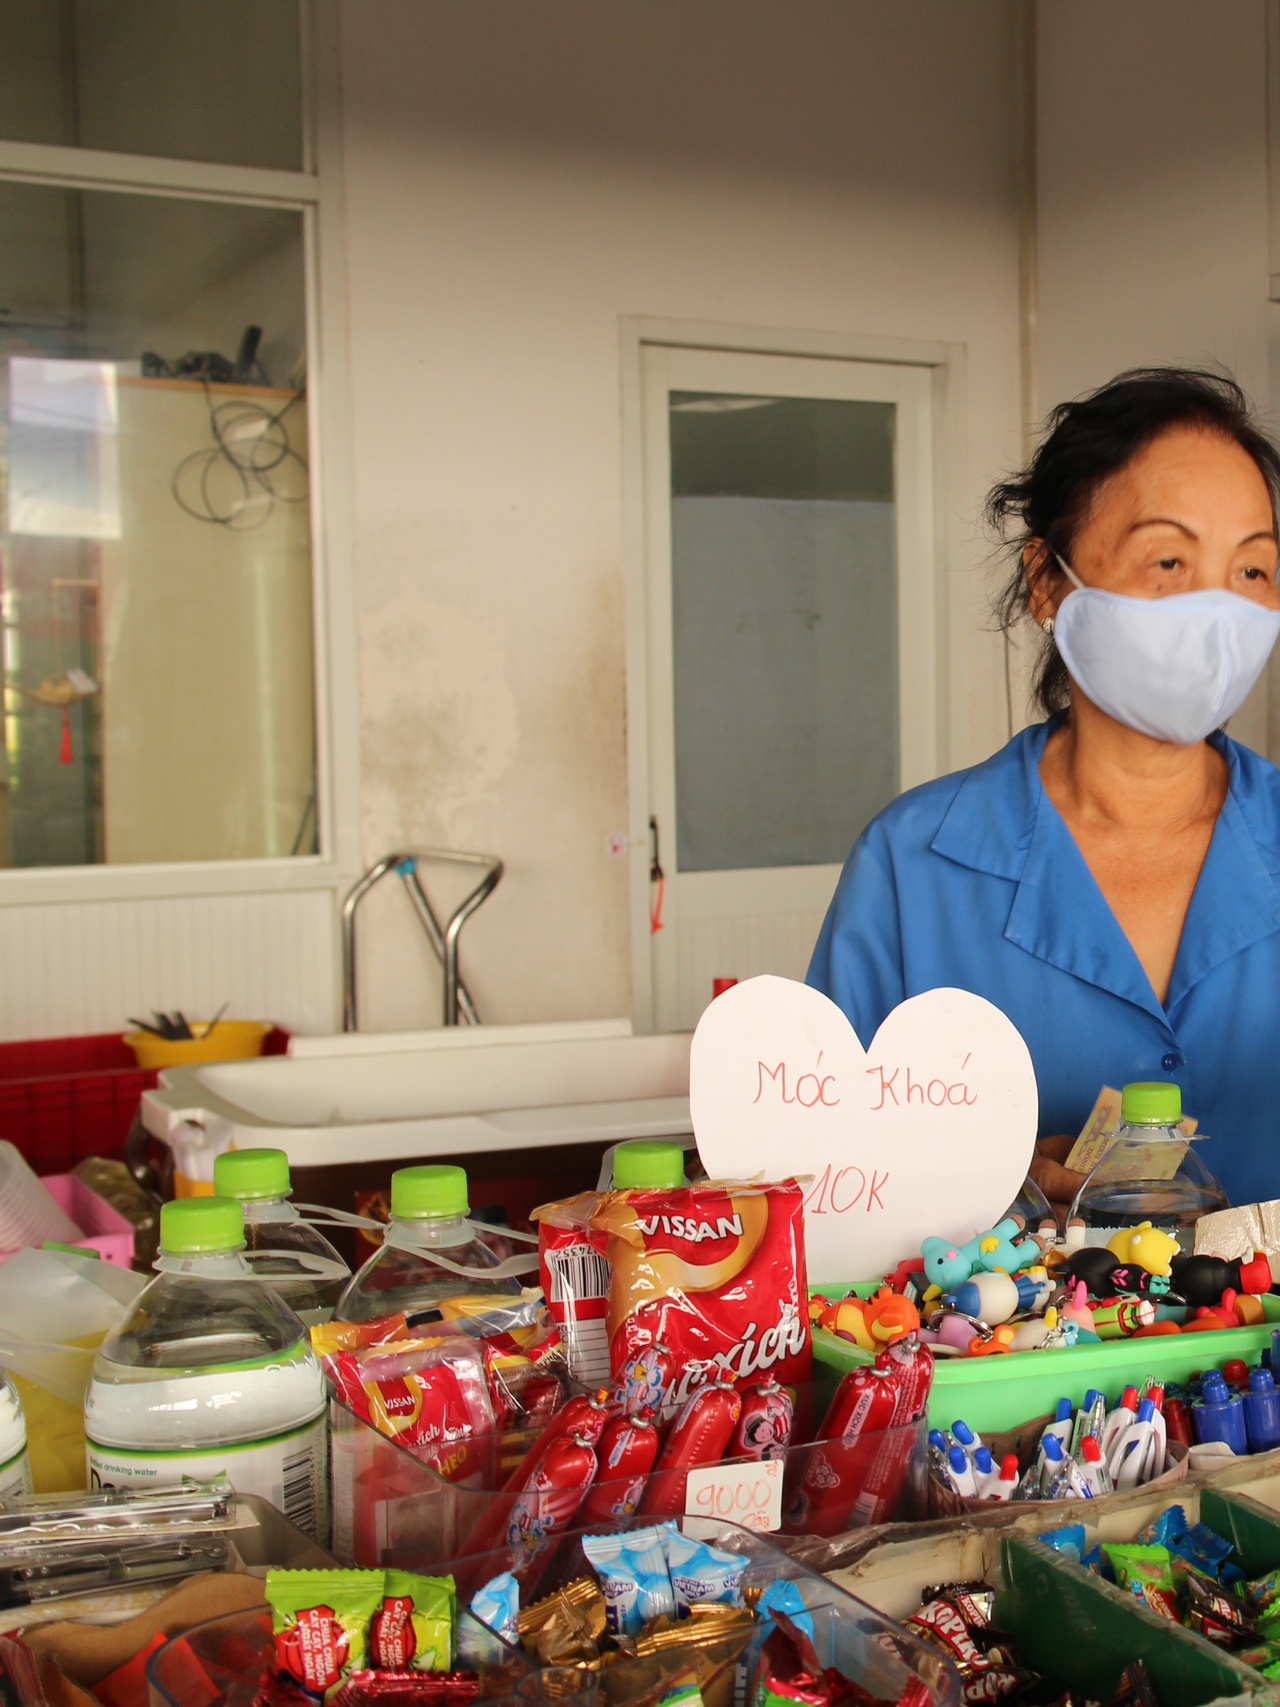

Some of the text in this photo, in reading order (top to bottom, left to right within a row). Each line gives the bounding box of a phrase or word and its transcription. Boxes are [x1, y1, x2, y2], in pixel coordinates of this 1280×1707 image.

[753, 1050, 978, 1110] Móc Khoá
[635, 1212, 744, 1242] VISSAN
[556, 1244, 598, 1259] 74352
[713, 1312, 806, 1384] xích
[383, 1395, 416, 1410] VISSAN
[104, 1462, 158, 1477] drinking water
[441, 1446, 467, 1474] HEO
[696, 1479, 772, 1518] 9000
[674, 1578, 716, 1593] VIETNAM
[393, 1600, 403, 1620] CAY
[960, 1596, 987, 1629] KOPIK
[309, 1609, 320, 1628] CAY
[315, 1653, 326, 1686] NGON
[320, 1617, 334, 1675] CHUA CHUA
[917, 1600, 992, 1667] KOPIKO
[394, 1639, 404, 1665] CHUA
[966, 1671, 1018, 1701] KOP
